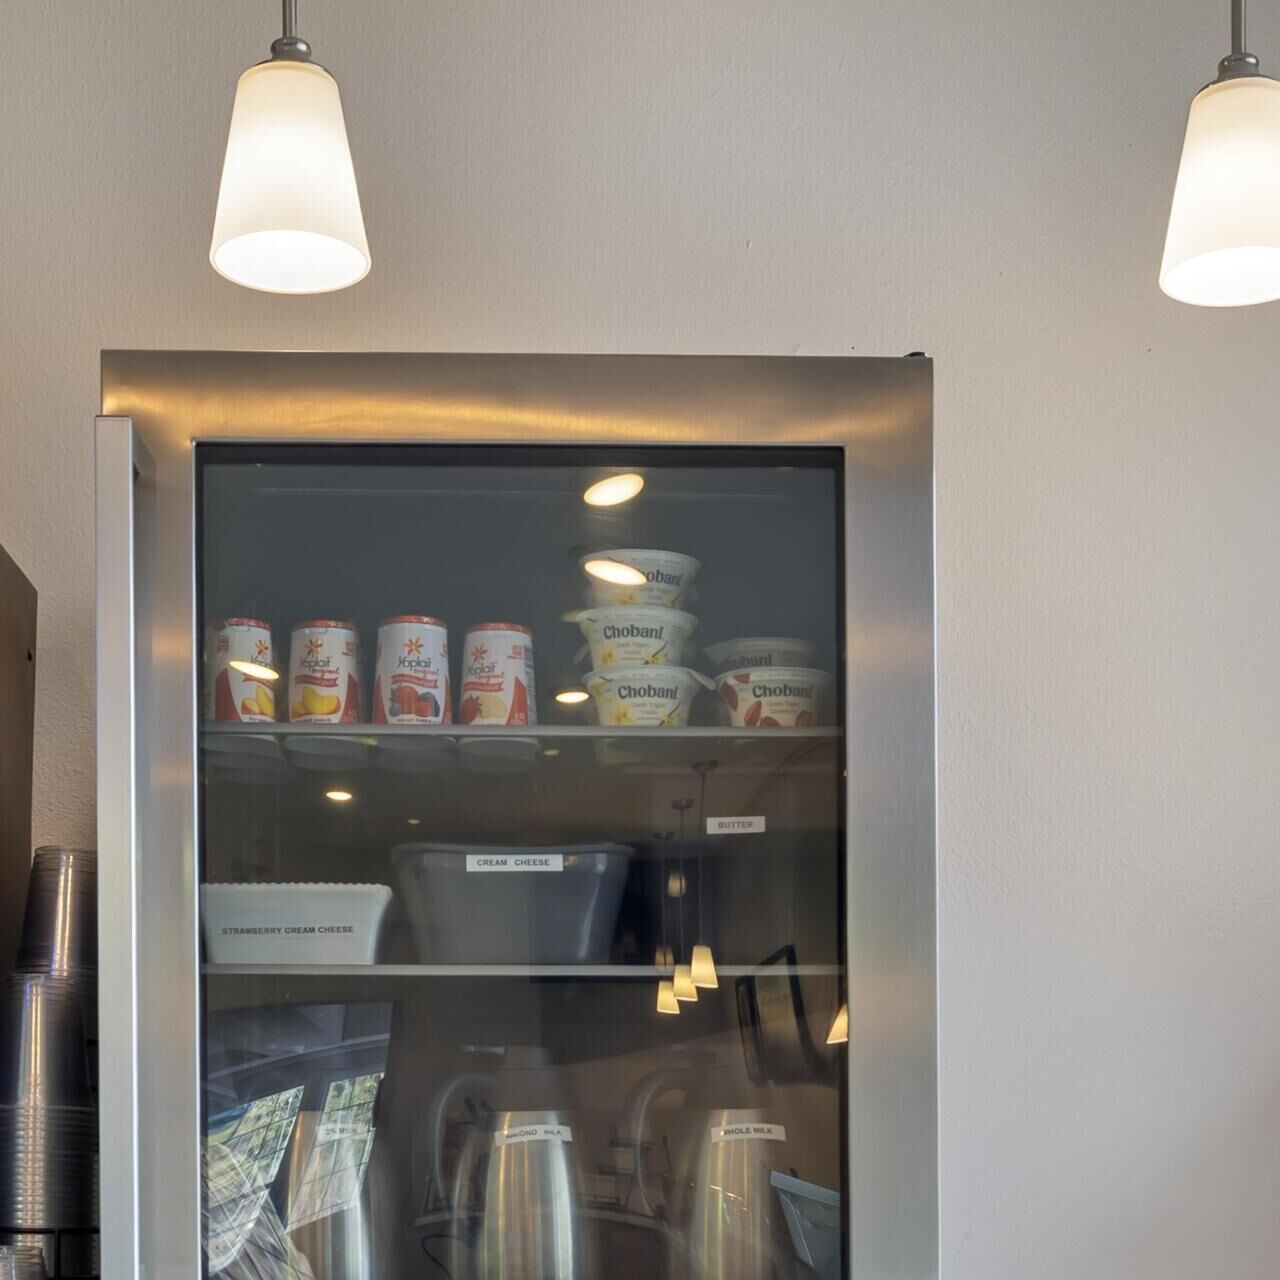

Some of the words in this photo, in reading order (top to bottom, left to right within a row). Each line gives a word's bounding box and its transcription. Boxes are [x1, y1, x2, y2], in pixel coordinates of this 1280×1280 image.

[603, 624, 665, 640] Chobani
[397, 656, 433, 671] Yoplait
[618, 684, 679, 700] Chobani
[752, 684, 814, 698] Chobani
[718, 821, 753, 829] BUTTER
[514, 858, 551, 866] CHEESE
[222, 927, 282, 935] STRAWBERRY
[284, 926, 315, 934] CREAM
[317, 926, 354, 934] CHEESE
